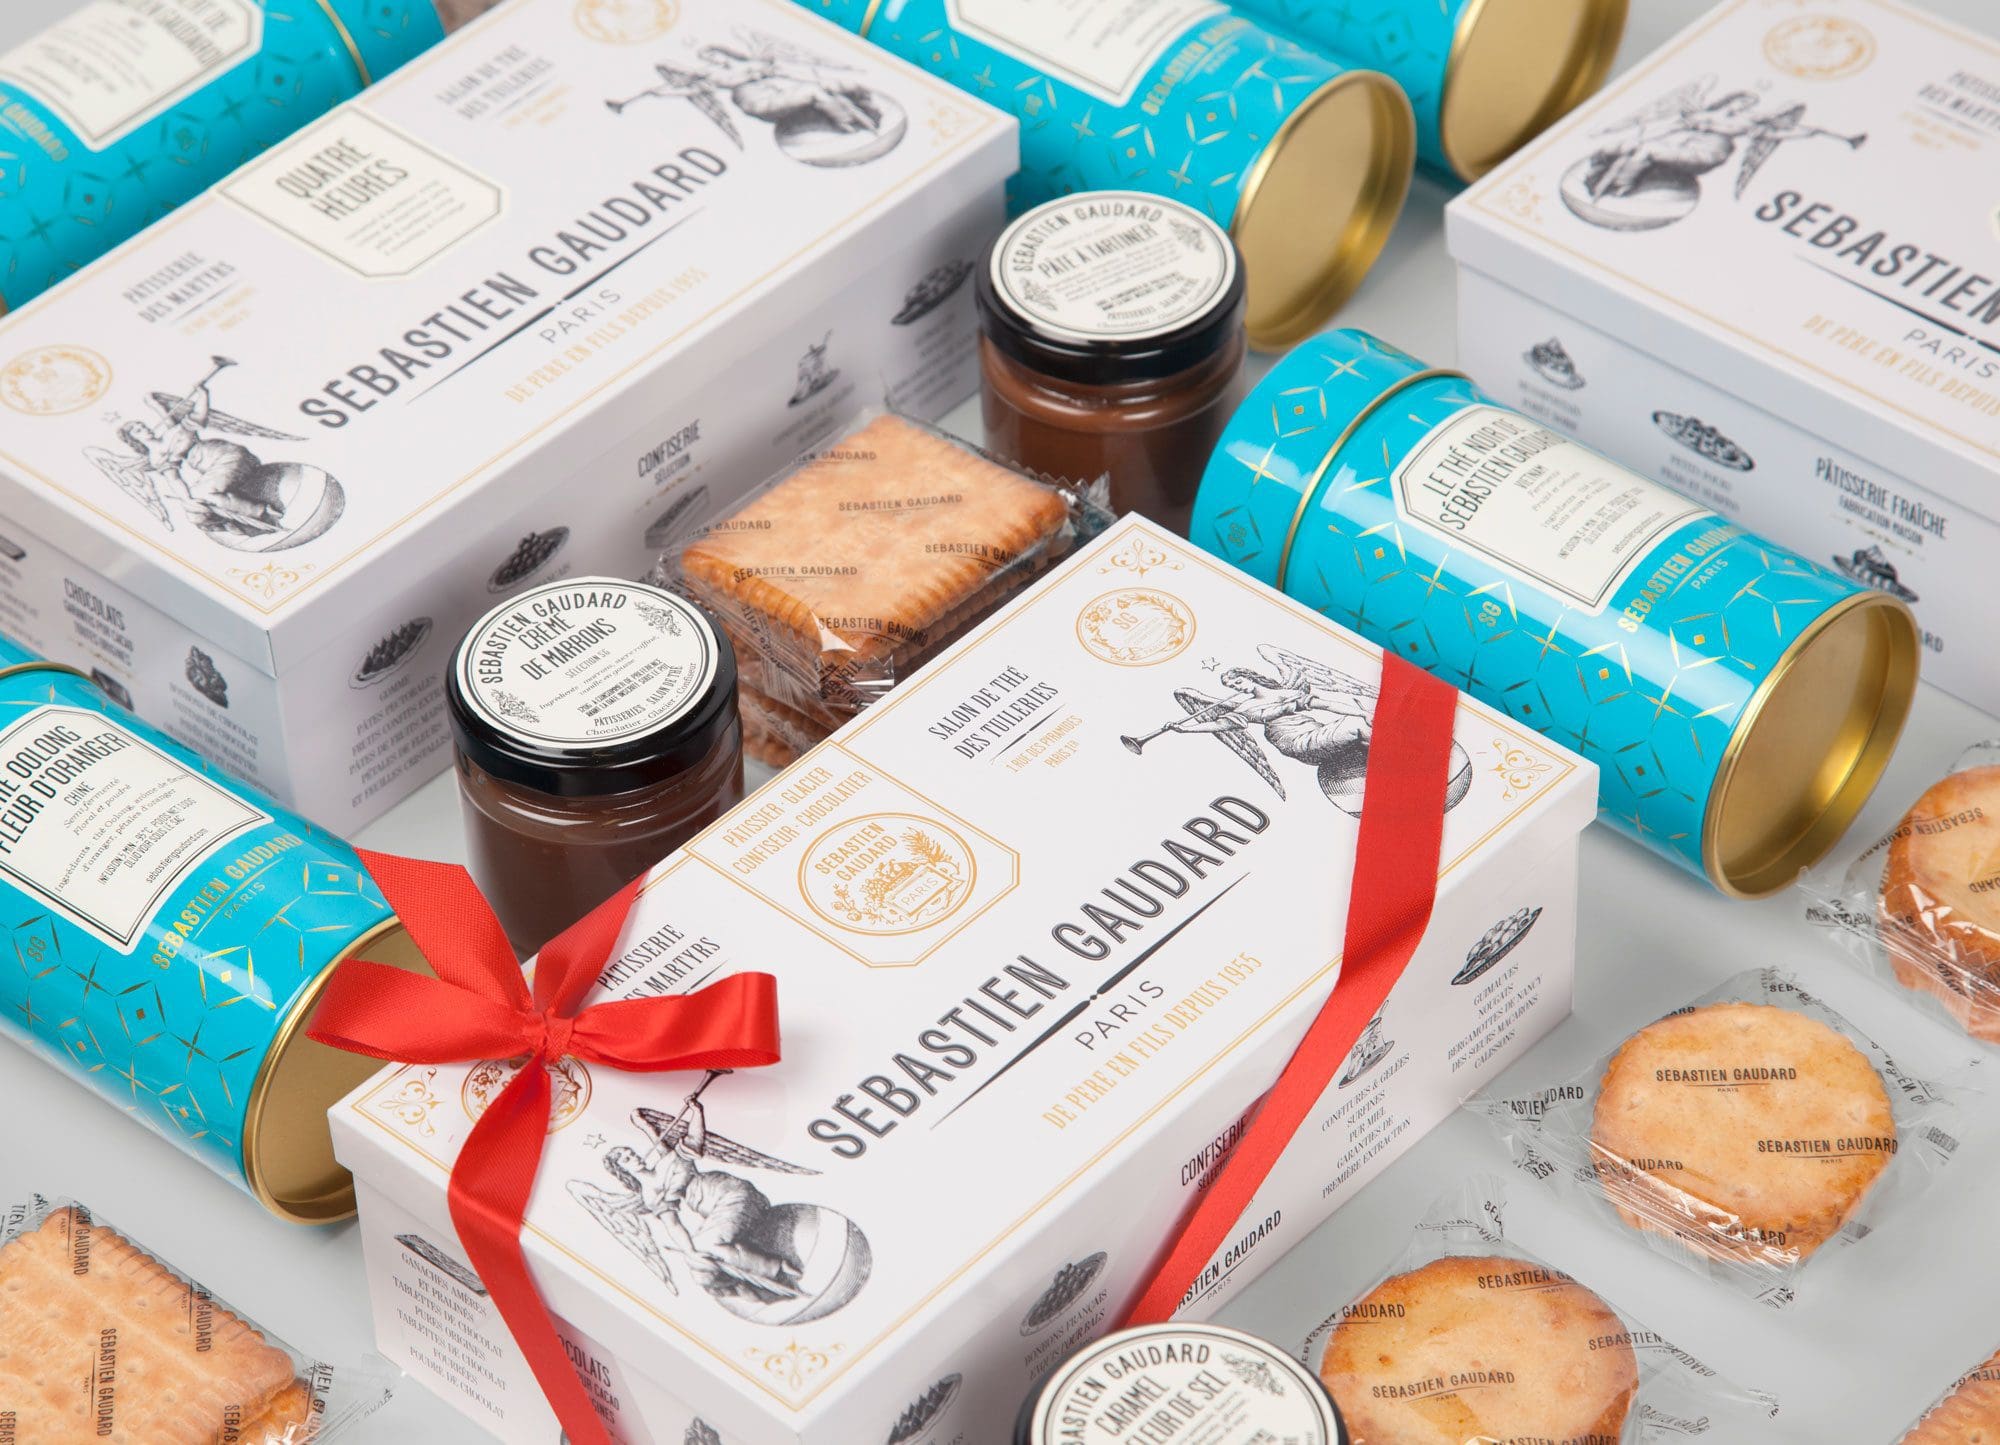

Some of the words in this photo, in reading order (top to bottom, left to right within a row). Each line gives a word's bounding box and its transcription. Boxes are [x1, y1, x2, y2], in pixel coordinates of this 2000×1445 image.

[276, 137, 372, 199] QUATRE
[310, 158, 409, 221] HEURES
[528, 146, 728, 276] GAUDARD
[1013, 213, 1071, 272] SEBASTIEN
[1074, 203, 1163, 222] GAUDARD
[1088, 222, 1160, 258] TARTINER
[539, 288, 623, 344] PARIS
[1903, 328, 1999, 379] PARIS
[505, 383, 535, 404] DE
[638, 418, 701, 478] CONFISERIE
[1437, 445, 1480, 477] THÉ
[1462, 426, 1509, 455] NOIR
[838, 500, 901, 512] SEBASTIEN
[907, 494, 963, 508] GAUDARD
[1422, 472, 1457, 498] LE
[1439, 455, 1517, 531] SÉBASTIEN
[715, 519, 772, 532] GAUDARD
[1839, 495, 1891, 528] FABRICATION
[925, 544, 989, 558] SEBASTIEN
[733, 567, 796, 584] SEBASTIEN
[801, 566, 858, 576] GAUDARD
[1616, 552, 1694, 633] SEBASTIEN
[1691, 559, 1729, 590] PARIS
[532, 592, 627, 618] GAUDARD
[1478, 600, 1502, 628] SG
[520, 657, 552, 681] DE
[541, 618, 617, 668] MARRONS
[585, 720, 642, 737] Chocolatier
[648, 698, 676, 719] Glacier
[676, 662, 697, 695] Confiseur
[646, 686, 667, 705] SALON
[663, 675, 676, 687] DE
[978, 687, 1000, 711] DE
[988, 664, 1030, 699] THÉ
[928, 701, 981, 741] SALON
[954, 728, 990, 760] DES
[980, 680, 1060, 737] TUILERIES
[6, 725, 82, 779] OOLONG
[30, 732, 131, 799] D'ORANGER
[64, 781, 95, 806] CHINE
[722, 802, 786, 848] PÂTISSIER
[781, 766, 834, 805] GLACIER
[74, 812, 98, 836] Floral
[97, 805, 105, 813] et
[732, 827, 800, 875] CONFISEUR
[795, 770, 873, 826] CHOCOLATIER
[1915, 807, 1984, 835] SEBASTIEN
[97, 855, 123, 885] INFUSION
[836, 834, 897, 882] GAUDARD
[1051, 795, 1270, 960] GAUDARD
[151, 877, 230, 970] SEBASTIEN
[224, 833, 303, 879] GAUDARD
[224, 882, 265, 920] PARIS
[901, 876, 939, 906] PARIS
[27, 936, 47, 963] SG
[644, 936, 721, 994] MARTYRS
[1074, 980, 1164, 1051] PARIS
[1042, 1103, 1077, 1130] DE
[1105, 1051, 1140, 1078] EN
[1127, 1023, 1175, 1059] FILS
[1163, 979, 1230, 1030] DEPUIS
[1217, 951, 1262, 987] 1955
[1656, 1068, 1727, 1082] SEBASTIEN
[1733, 1067, 1797, 1080] GAUDARD
[1321, 1087, 1371, 1132] CONFITURES
[1347, 1089, 1386, 1128] SURFINES
[1349, 1122, 1365, 1143] PUR
[1367, 1107, 1386, 1126] MIEL
[1181, 1113, 1249, 1187] CONFISERIE
[1336, 1127, 1381, 1169] GARANTIES
[1383, 1114, 1394, 1130] DE
[1363, 1117, 1411, 1165] EXTRACTION
[1758, 1139, 1830, 1153] SEBASTIEN
[1836, 1136, 1898, 1155] GAUDARD
[74, 1228, 90, 1276] GAUDARD
[1224, 1210, 1281, 1267] GAUDARD
[401, 1252, 450, 1290] GANACHES
[418, 1278, 430, 1292] ET
[1207, 1276, 1232, 1301] PARIS
[1478, 1269, 1550, 1290] SEBASTIEN
[196, 1304, 212, 1352] GAUDARD
[392, 1276, 446, 1315] TABLETTES
[444, 1309, 455, 1325] DE
[457, 1319, 504, 1358] CHOCOLAT
[1342, 1304, 1405, 1318] GAUDARD
[396, 1308, 446, 1347] TABLETTES
[461, 1351, 507, 1390] CHOCOLAT
[414, 1306, 443, 1332] PURES
[445, 1326, 486, 1360] ORIGINES
[1588, 1332, 1663, 1351] SEBASTIEN
[99, 1328, 116, 1384] SEBASTIEN
[1103, 1343, 1211, 1380] GAUDARD
[409, 1346, 445, 1378] POUDRE
[446, 1371, 458, 1387] DE
[459, 1379, 505, 1419] CHOCOLAT
[594, 1381, 620, 1411] CACAO
[1169, 1392, 1200, 1419] DE
[1188, 1369, 1232, 1401] SEL
[1450, 1370, 1515, 1386] GAUDARD
[97, 1387, 114, 1437] GAUDARD
[1094, 1374, 1170, 1437] CARAMEL
